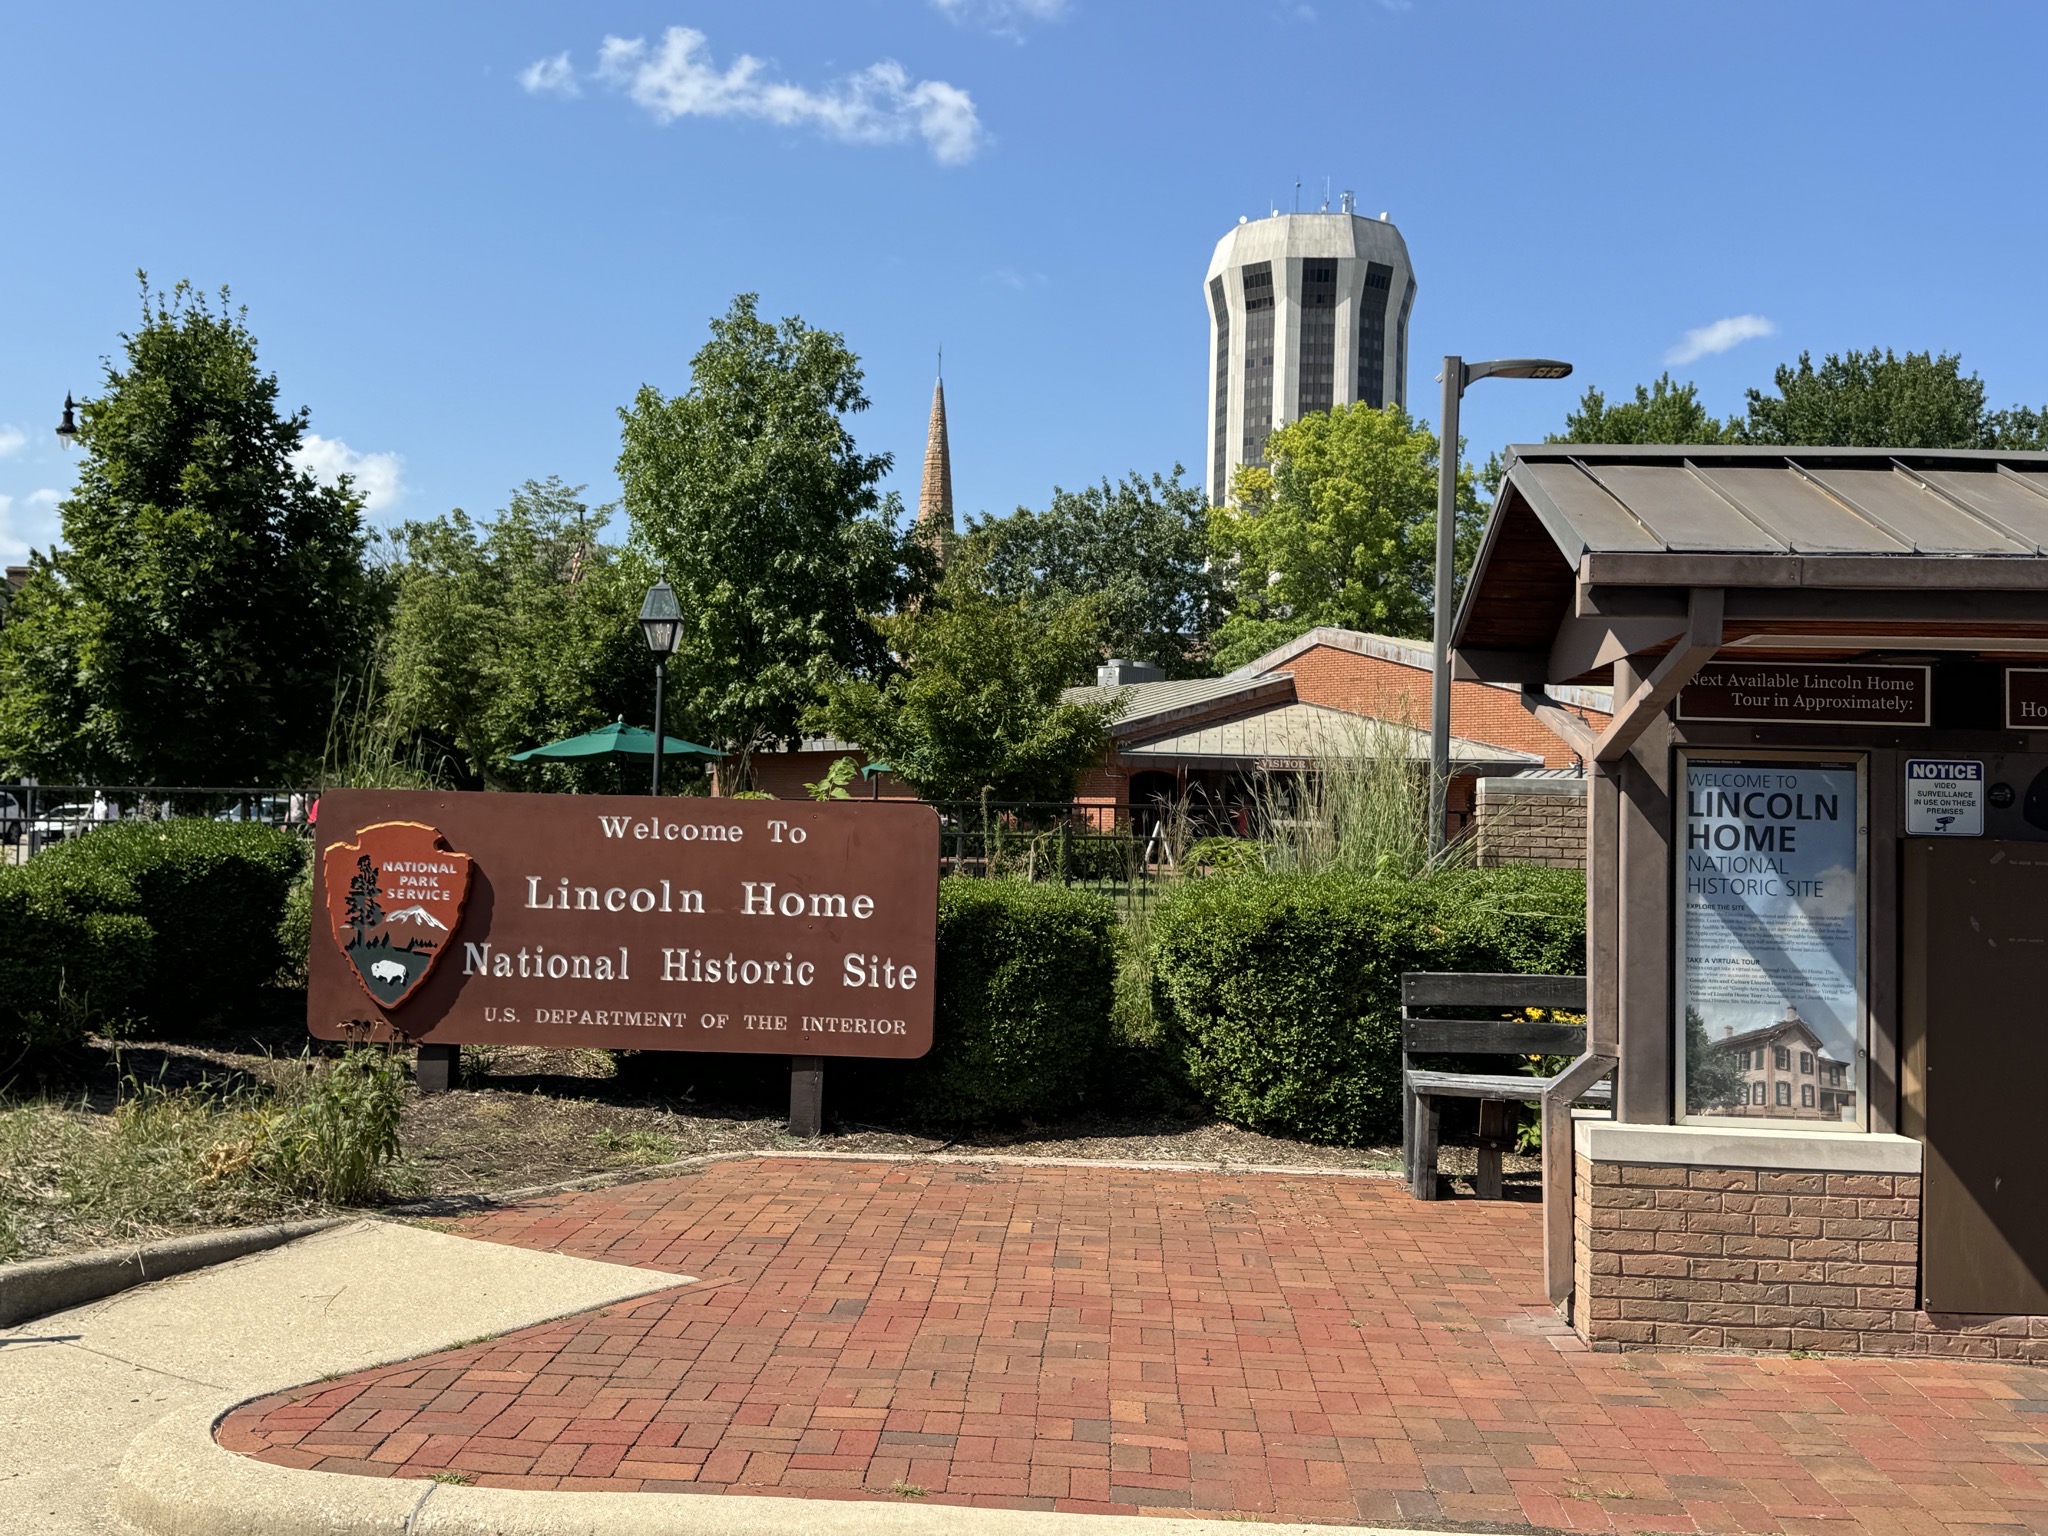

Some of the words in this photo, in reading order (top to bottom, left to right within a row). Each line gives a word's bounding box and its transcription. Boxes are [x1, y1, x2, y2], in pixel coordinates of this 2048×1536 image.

[1687, 673, 1723, 686] Next
[1727, 673, 1799, 688] Available
[1804, 674, 1863, 689] Lincoln
[1867, 676, 1914, 691] Home
[1731, 692, 1770, 706] Tour
[1774, 693, 1789, 707] in
[1793, 694, 1913, 713] Approximately:
[1261, 759, 1306, 769] VISITOR
[1912, 764, 1977, 779] NOTICE
[1687, 773, 1771, 790] WELCOME
[1776, 777, 1798, 790] TO
[1934, 782, 1957, 790] VIDEO
[1917, 790, 1973, 798] SURVEILLANCE
[1688, 790, 1838, 821] LINCOLN
[1926, 807, 1965, 816] PREMISES
[1940, 799, 1951, 807] ON
[1952, 800, 1977, 808] THESE
[599, 816, 743, 843] Welcome
[768, 820, 807, 844] To
[1688, 823, 1796, 853] HOME
[383, 861, 457, 874] NATIONAL
[1688, 855, 1790, 876] NATIONAL
[400, 875, 439, 887] PARK
[1688, 878, 1778, 898] HISTORIC
[1786, 881, 1824, 899] SITE
[387, 888, 450, 901] SERVICE
[525, 876, 705, 914] Lincoln
[741, 881, 875, 919] Home
[463, 942, 630, 980] National
[660, 948, 815, 986] Historic
[843, 953, 918, 990] Site
[1711, 957, 1740, 965] VIRTUAL
[1741, 958, 1761, 966] TOUR
[484, 1007, 520, 1023] U.S.
[535, 1009, 686, 1028] DEPARTMENT
[701, 1013, 728, 1029] OF
[744, 1014, 788, 1031] THE
[801, 1016, 907, 1035] INTERIOR
